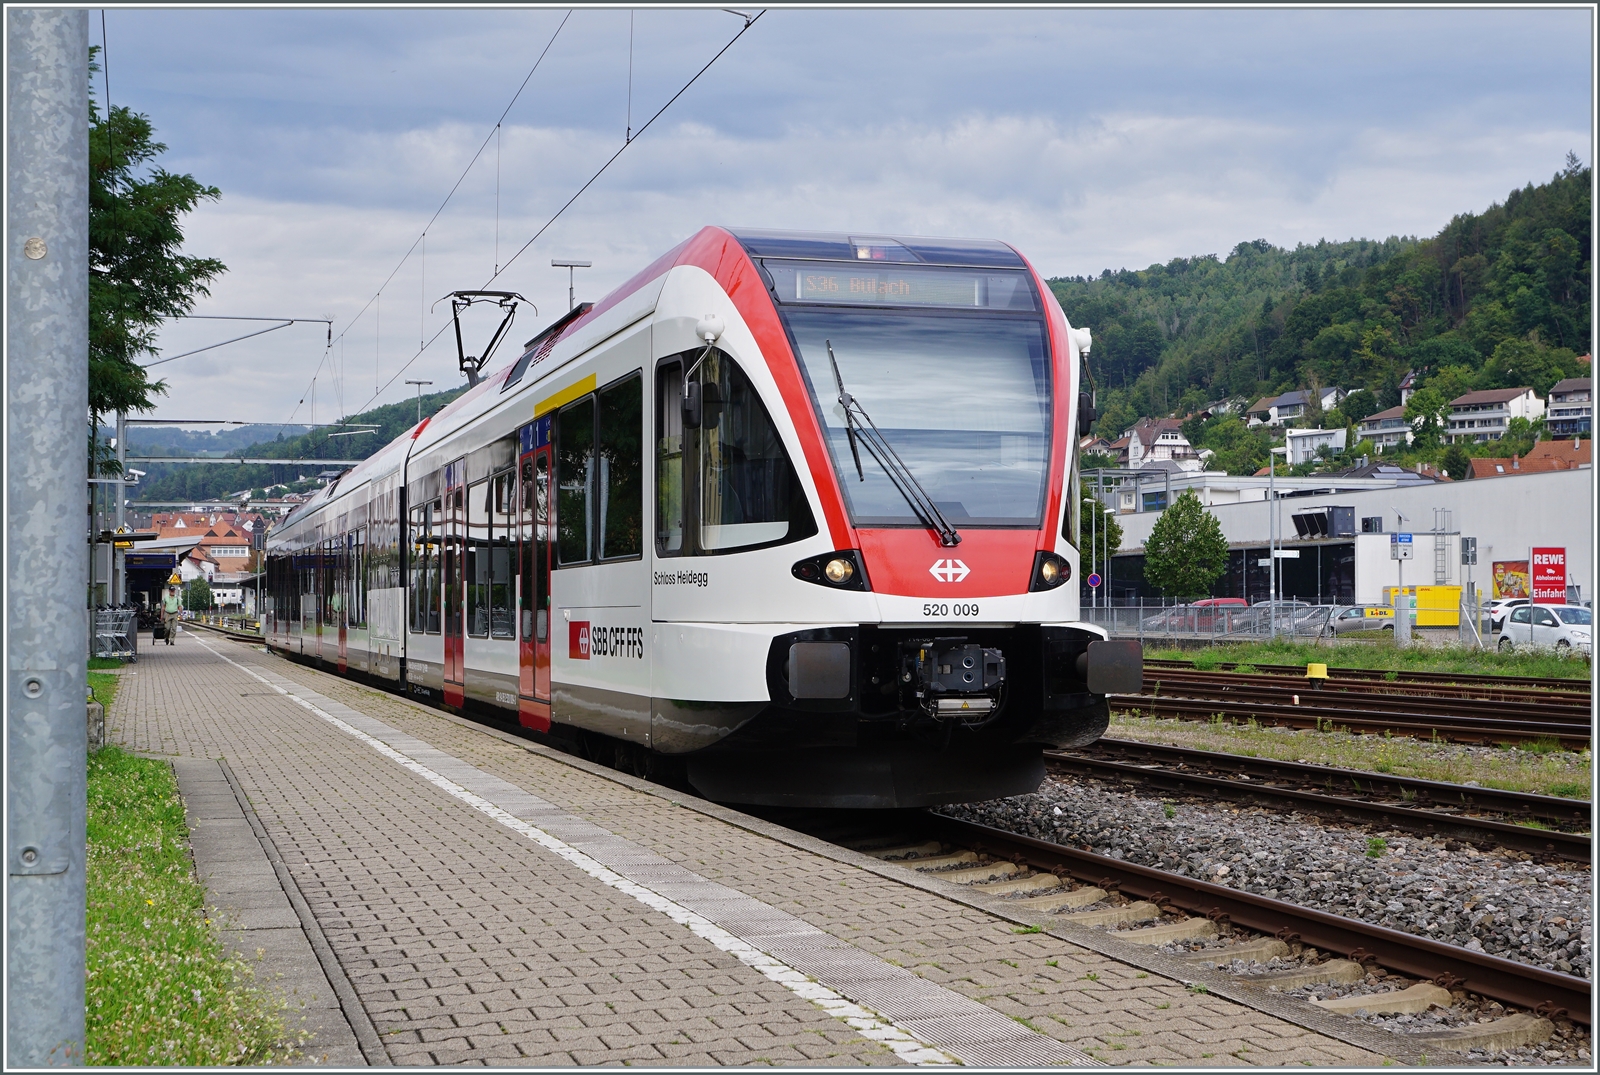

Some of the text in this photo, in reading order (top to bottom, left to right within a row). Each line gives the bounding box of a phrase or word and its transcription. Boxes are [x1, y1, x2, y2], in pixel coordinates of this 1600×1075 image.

[806, 275, 910, 295] S36 Bülach
[529, 425, 533, 449] 2
[1533, 554, 1564, 565] REWE
[653, 570, 708, 587] Schloss Heidegg
[1533, 588, 1566, 598] Einfahrt
[923, 603, 980, 616] 520 009
[592, 626, 643, 660] SBB CFF FFS
